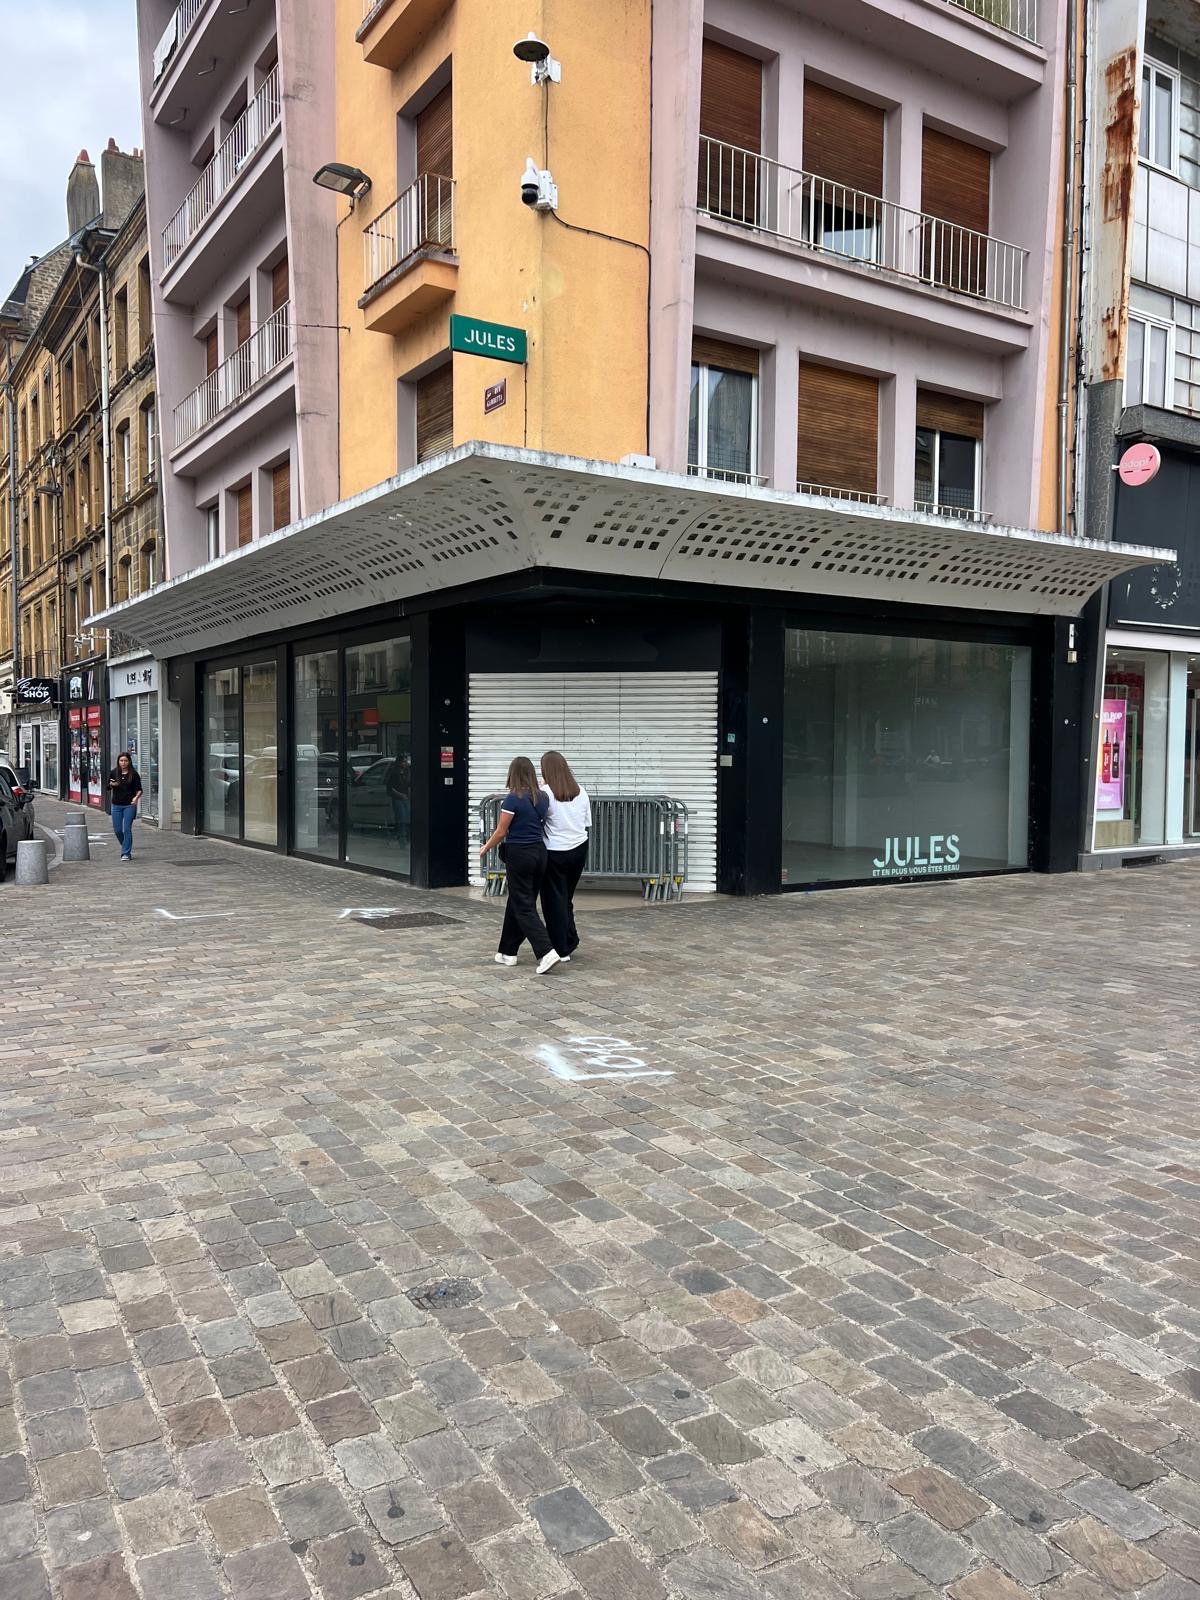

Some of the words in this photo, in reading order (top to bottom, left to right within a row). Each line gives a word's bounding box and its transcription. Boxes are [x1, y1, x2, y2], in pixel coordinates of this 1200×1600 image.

[464, 329, 515, 352] JULES
[18, 681, 50, 694] Barber
[24, 690, 50, 698] SHOP
[873, 834, 960, 868] JULES
[872, 869, 880, 877] ET
[881, 868, 890, 876] EN
[891, 867, 908, 875] PLUS
[909, 866, 926, 874] VOUS
[928, 864, 943, 873] ÊTES
[943, 864, 960, 872] BEAU
